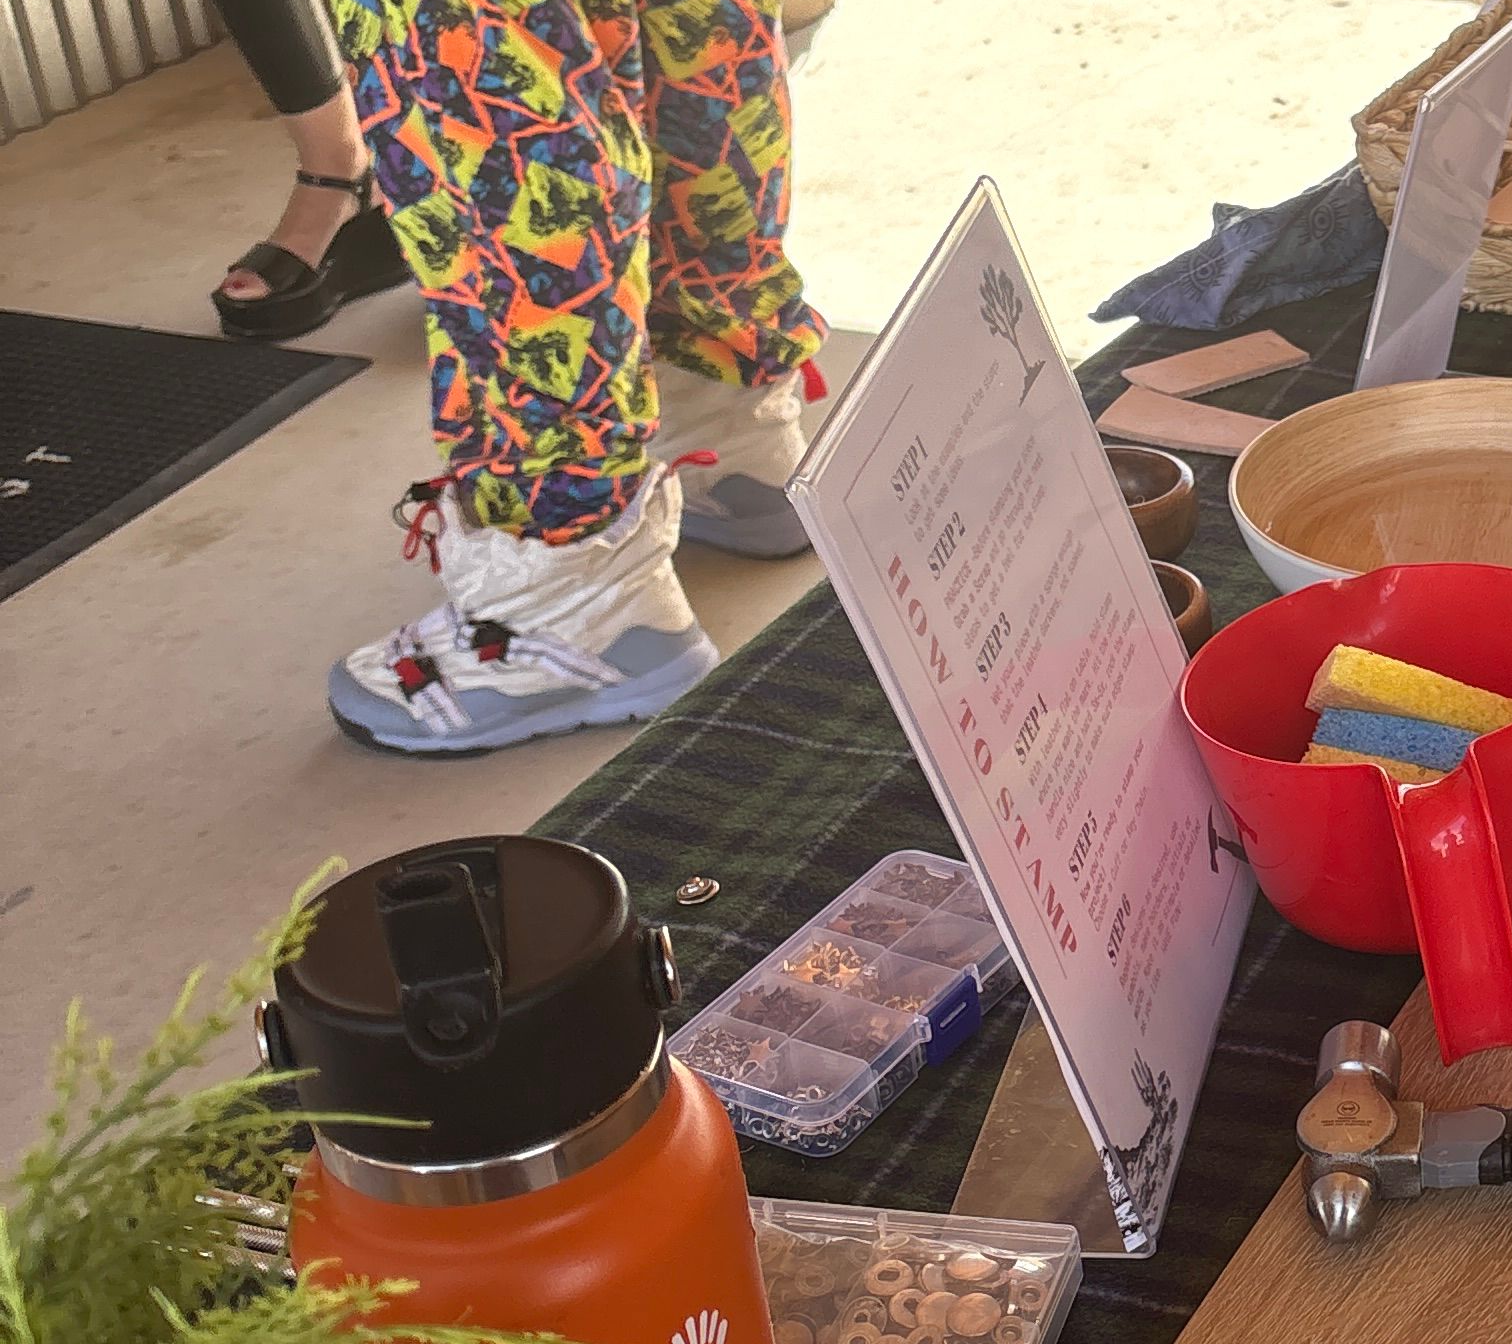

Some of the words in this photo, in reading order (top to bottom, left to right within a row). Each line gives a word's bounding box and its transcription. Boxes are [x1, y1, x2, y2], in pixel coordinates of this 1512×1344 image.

[971, 387, 984, 408] the
[892, 445, 920, 502] STEP
[928, 523, 956, 580] STEP
[988, 580, 1001, 606] get
[1012, 528, 1024, 550] for
[1022, 510, 1033, 530] the
[977, 624, 1003, 682] STEP
[999, 697, 1014, 725] that
[1011, 676, 1024, 698] the
[1022, 636, 1042, 678] leather
[1000, 657, 1016, 689] your
[1014, 627, 1031, 662] piece
[1015, 705, 1040, 764] STEP
[1037, 772, 1053, 806] where
[1052, 750, 1064, 776] you
[1061, 724, 1073, 752] want
[1070, 704, 1081, 725] the
[1098, 636, 1108, 656] the
[1040, 716, 1061, 760] leather
[1058, 690, 1071, 716] flat
[1045, 785, 1064, 824] handle
[1062, 758, 1075, 786] nice
[1073, 734, 1083, 760] and
[1080, 709, 1093, 738] hard
[1113, 635, 1123, 655] the
[888, 555, 952, 683] HOW
[959, 698, 992, 775] TO
[997, 788, 1077, 952] STAMP
[1054, 813, 1068, 841] very
[1065, 766, 1088, 815] slightly
[1090, 724, 1103, 751] make
[1101, 698, 1113, 726] sure
[1110, 671, 1124, 701] edges
[1089, 842, 1105, 882] you're
[1102, 809, 1118, 842] ready
[1121, 763, 1134, 794] stamp
[1132, 737, 1144, 766] your
[1125, 816, 1138, 839] Key
[1068, 822, 1092, 882] STEP
[1107, 907, 1126, 967] STEP
